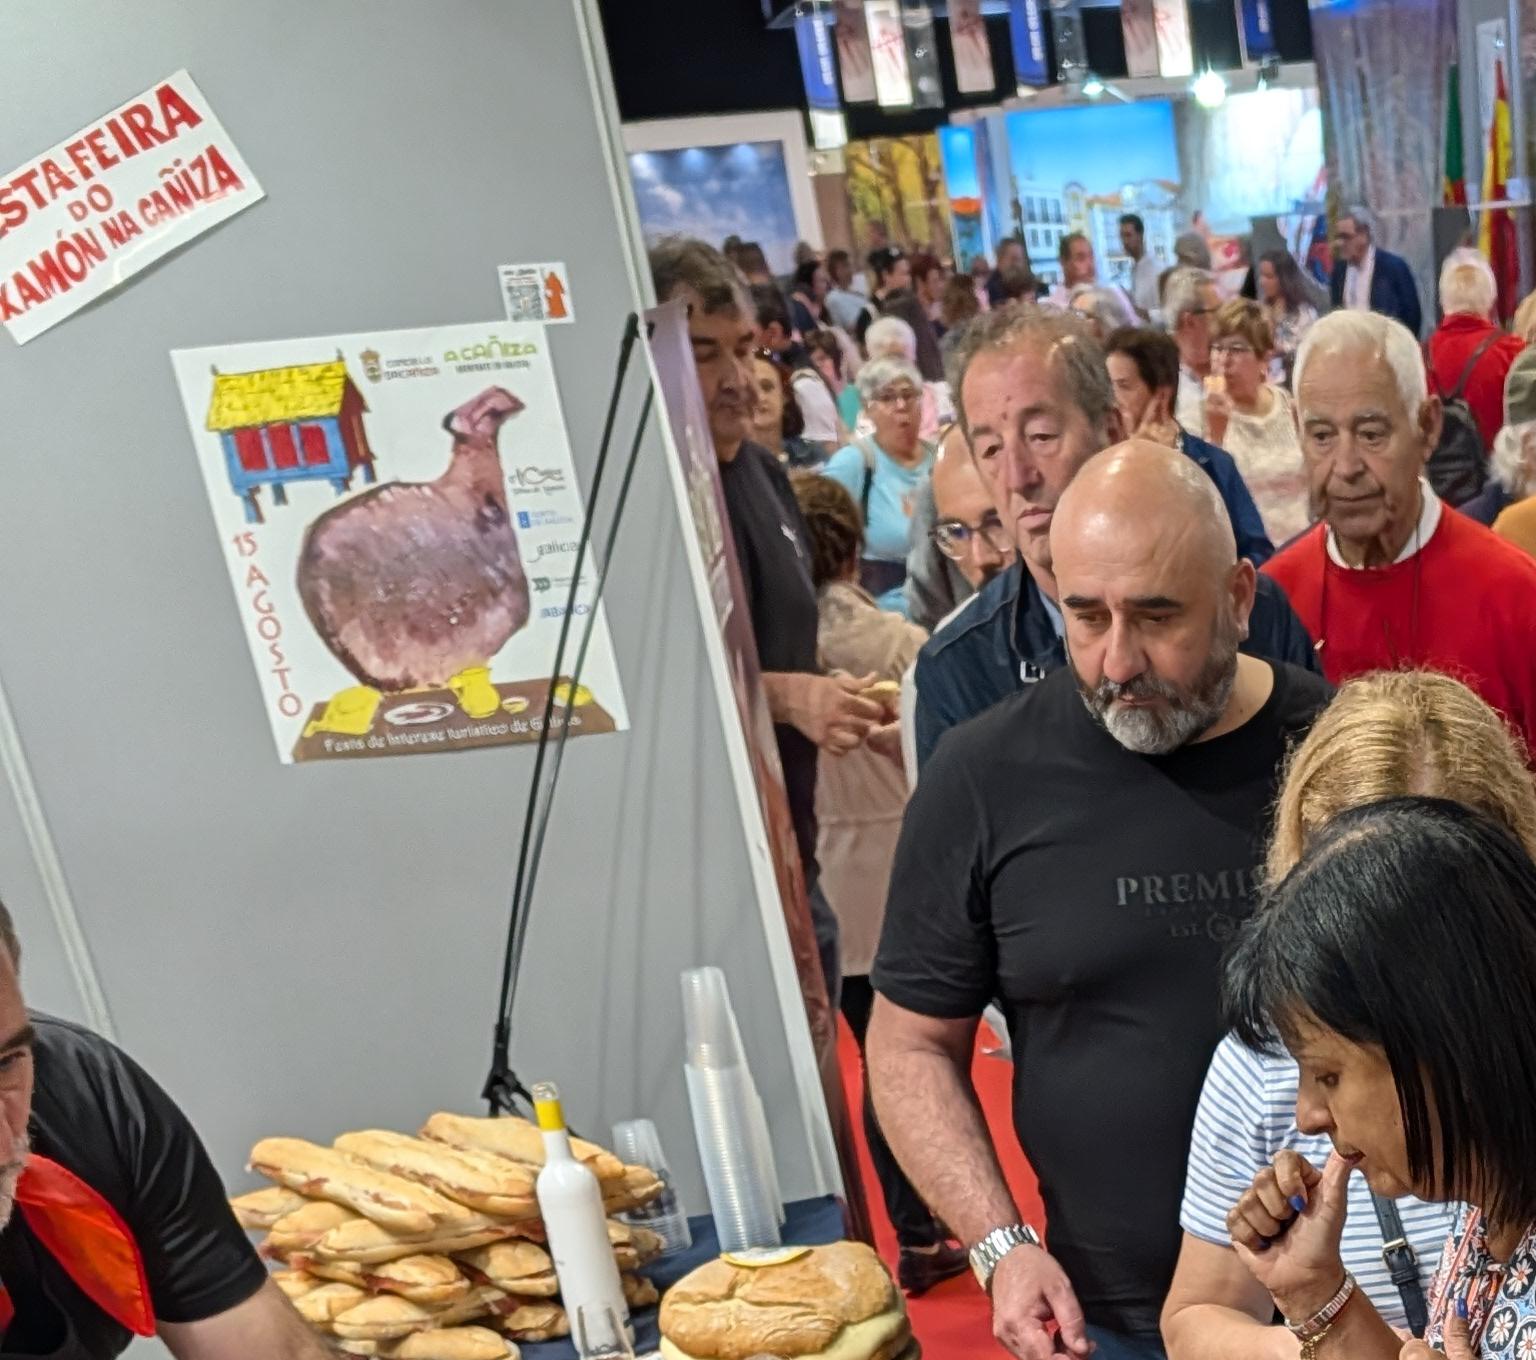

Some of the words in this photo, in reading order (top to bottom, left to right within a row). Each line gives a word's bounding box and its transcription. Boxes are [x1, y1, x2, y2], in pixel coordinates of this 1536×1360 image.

[0, 84, 203, 240] STA-FEIRA
[100, 210, 143, 250] NA
[137, 144, 245, 227] CAÑIZA
[66, 184, 114, 222] DO
[233, 532, 257, 557] 15
[247, 564, 303, 717] AGOSTO
[1116, 868, 1256, 906] PREMI
